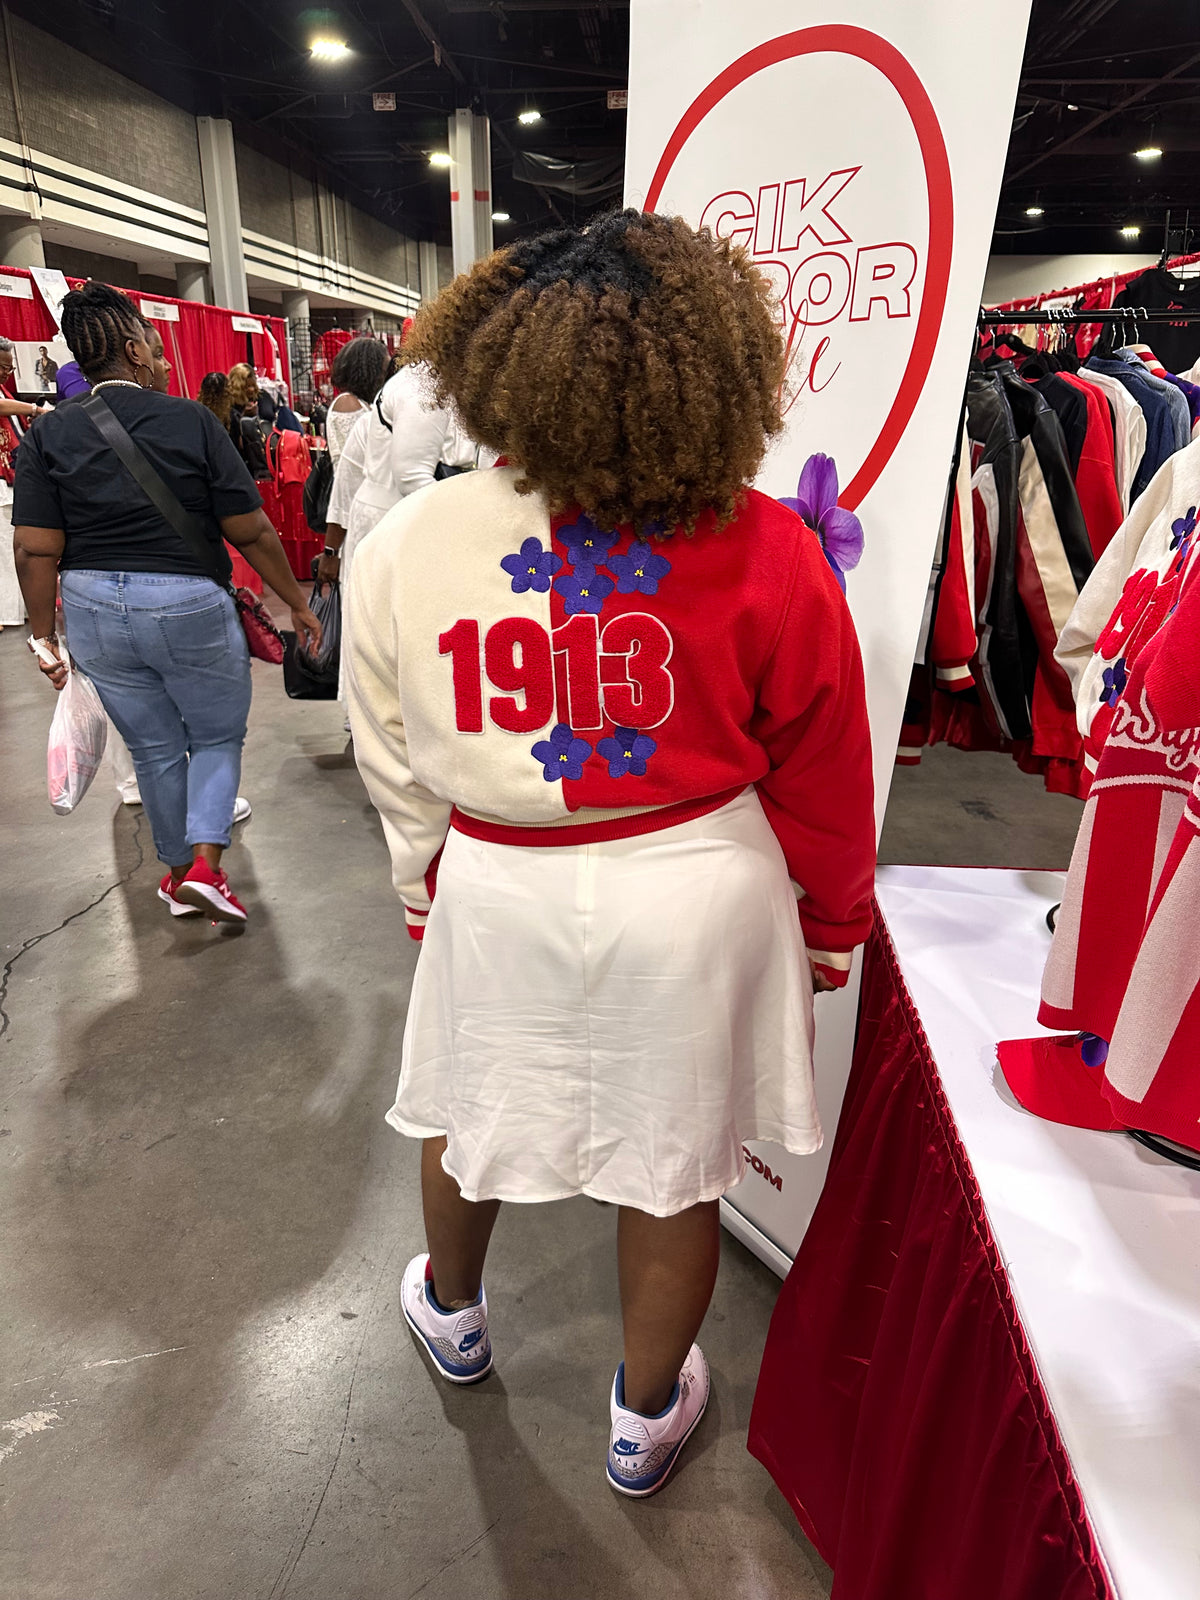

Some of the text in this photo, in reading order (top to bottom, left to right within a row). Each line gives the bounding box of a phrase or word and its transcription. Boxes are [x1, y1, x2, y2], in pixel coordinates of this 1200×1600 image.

[699, 165, 862, 256] CIK
[437, 612, 674, 735] 1913
[617, 1457, 638, 1469] AIR
